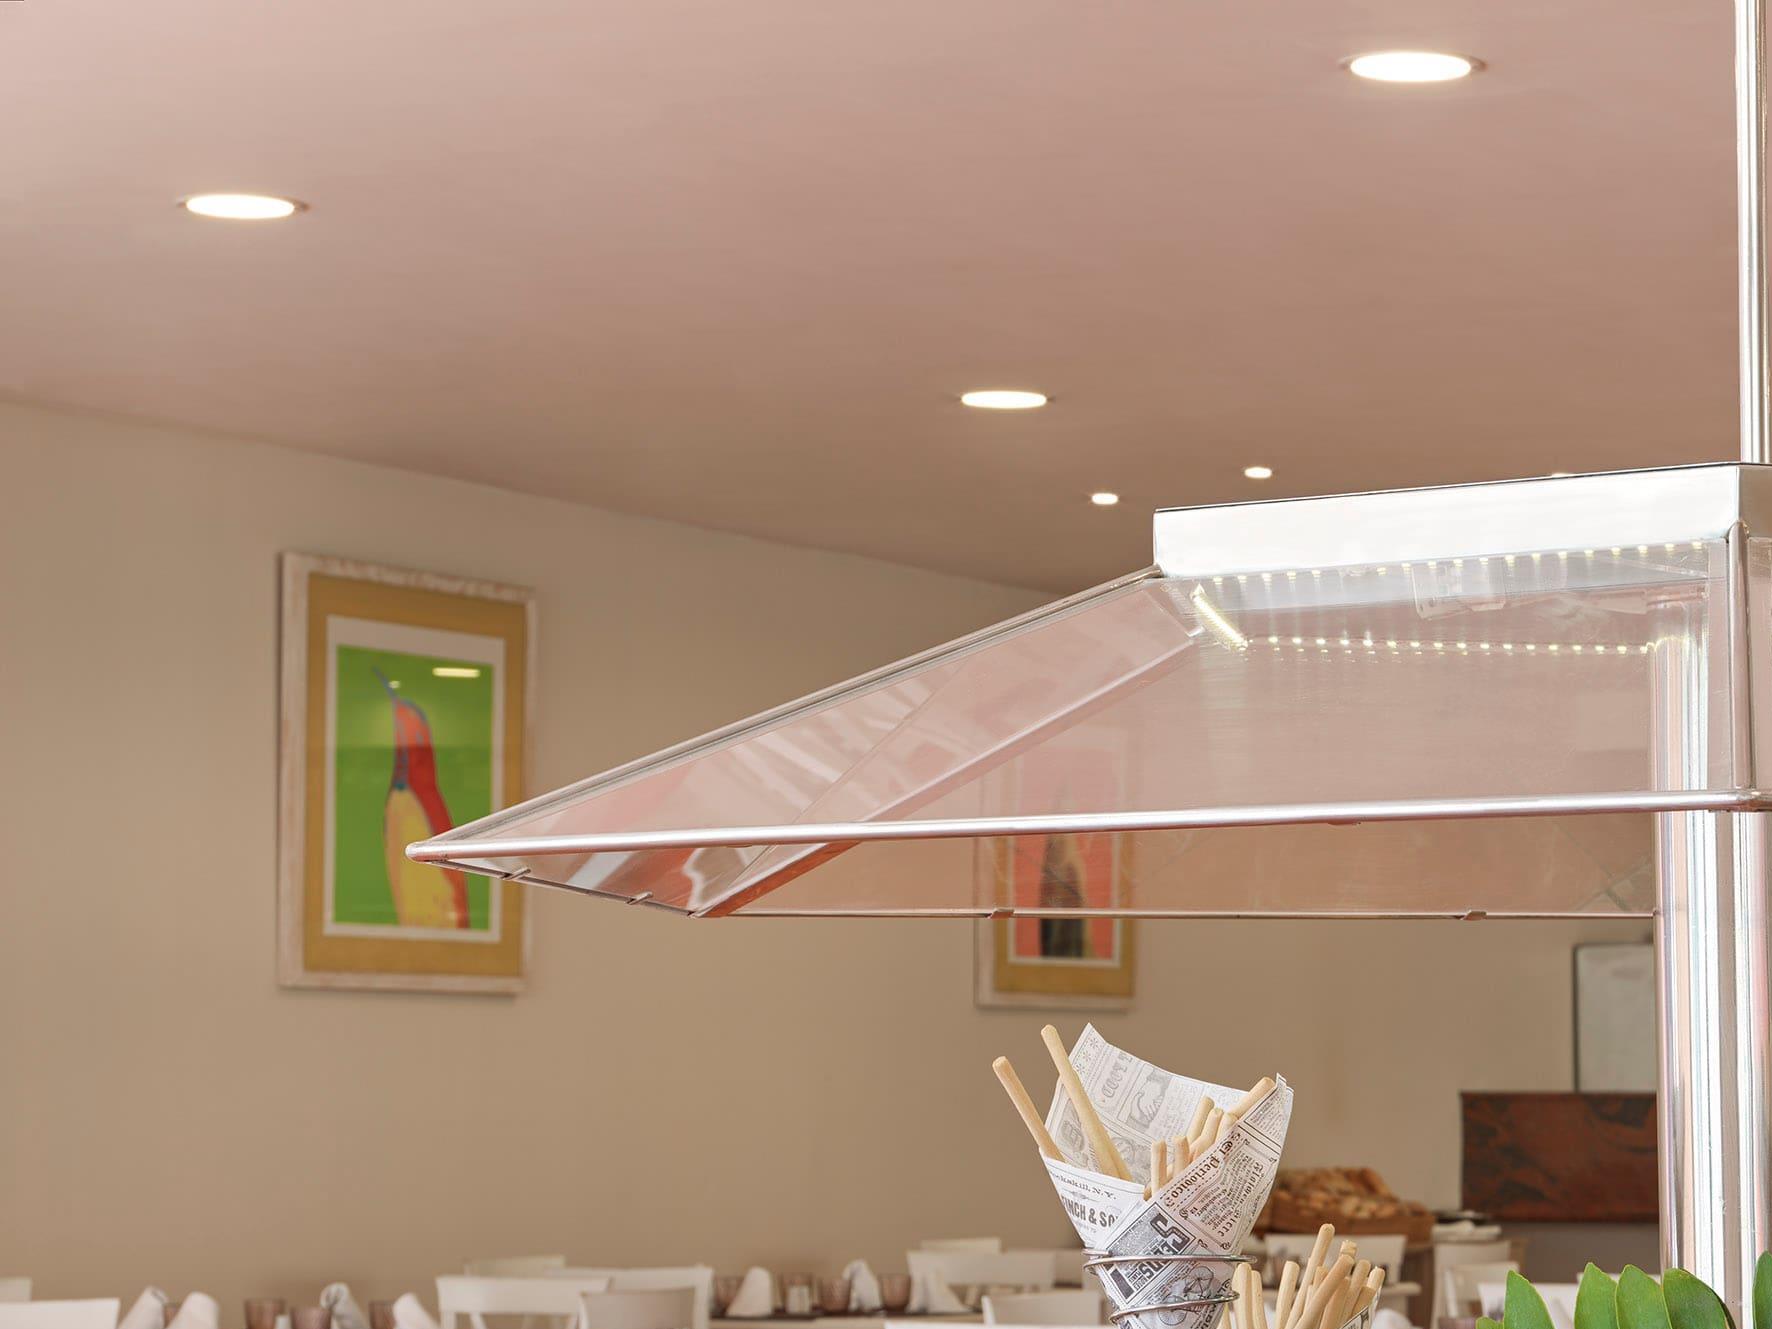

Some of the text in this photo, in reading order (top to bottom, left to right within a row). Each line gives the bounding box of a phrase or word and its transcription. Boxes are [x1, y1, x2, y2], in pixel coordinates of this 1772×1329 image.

[1219, 1140, 1234, 1155] El
[1088, 1207, 1098, 1225] &
[1099, 1211, 1119, 1228] SO
